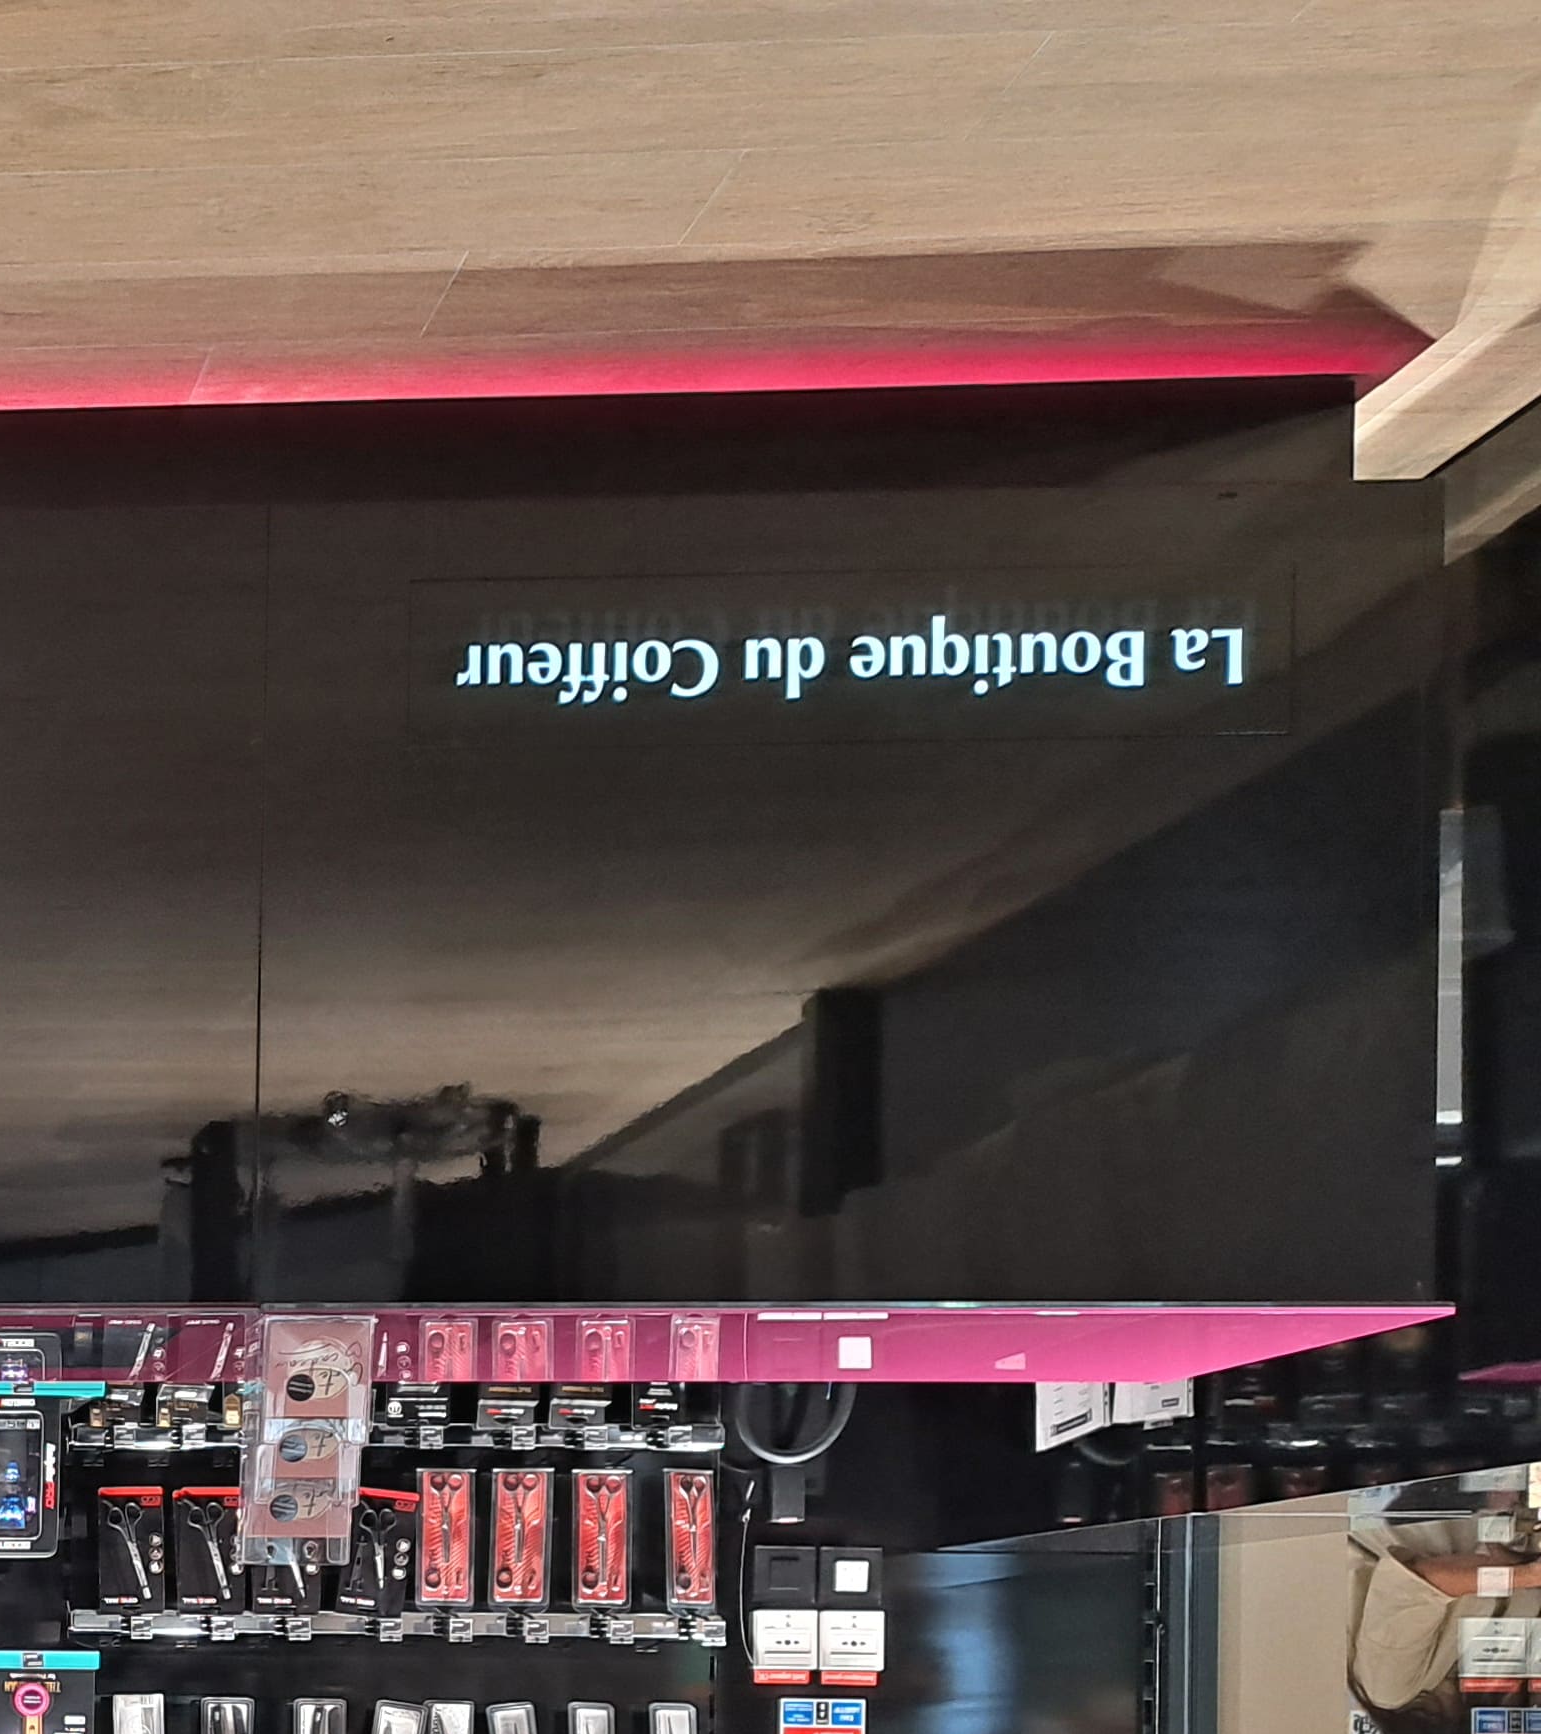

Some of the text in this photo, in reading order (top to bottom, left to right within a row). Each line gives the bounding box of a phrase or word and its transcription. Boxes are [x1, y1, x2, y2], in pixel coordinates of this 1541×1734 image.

[456, 615, 1245, 705] La Boutique du Coiffeur
